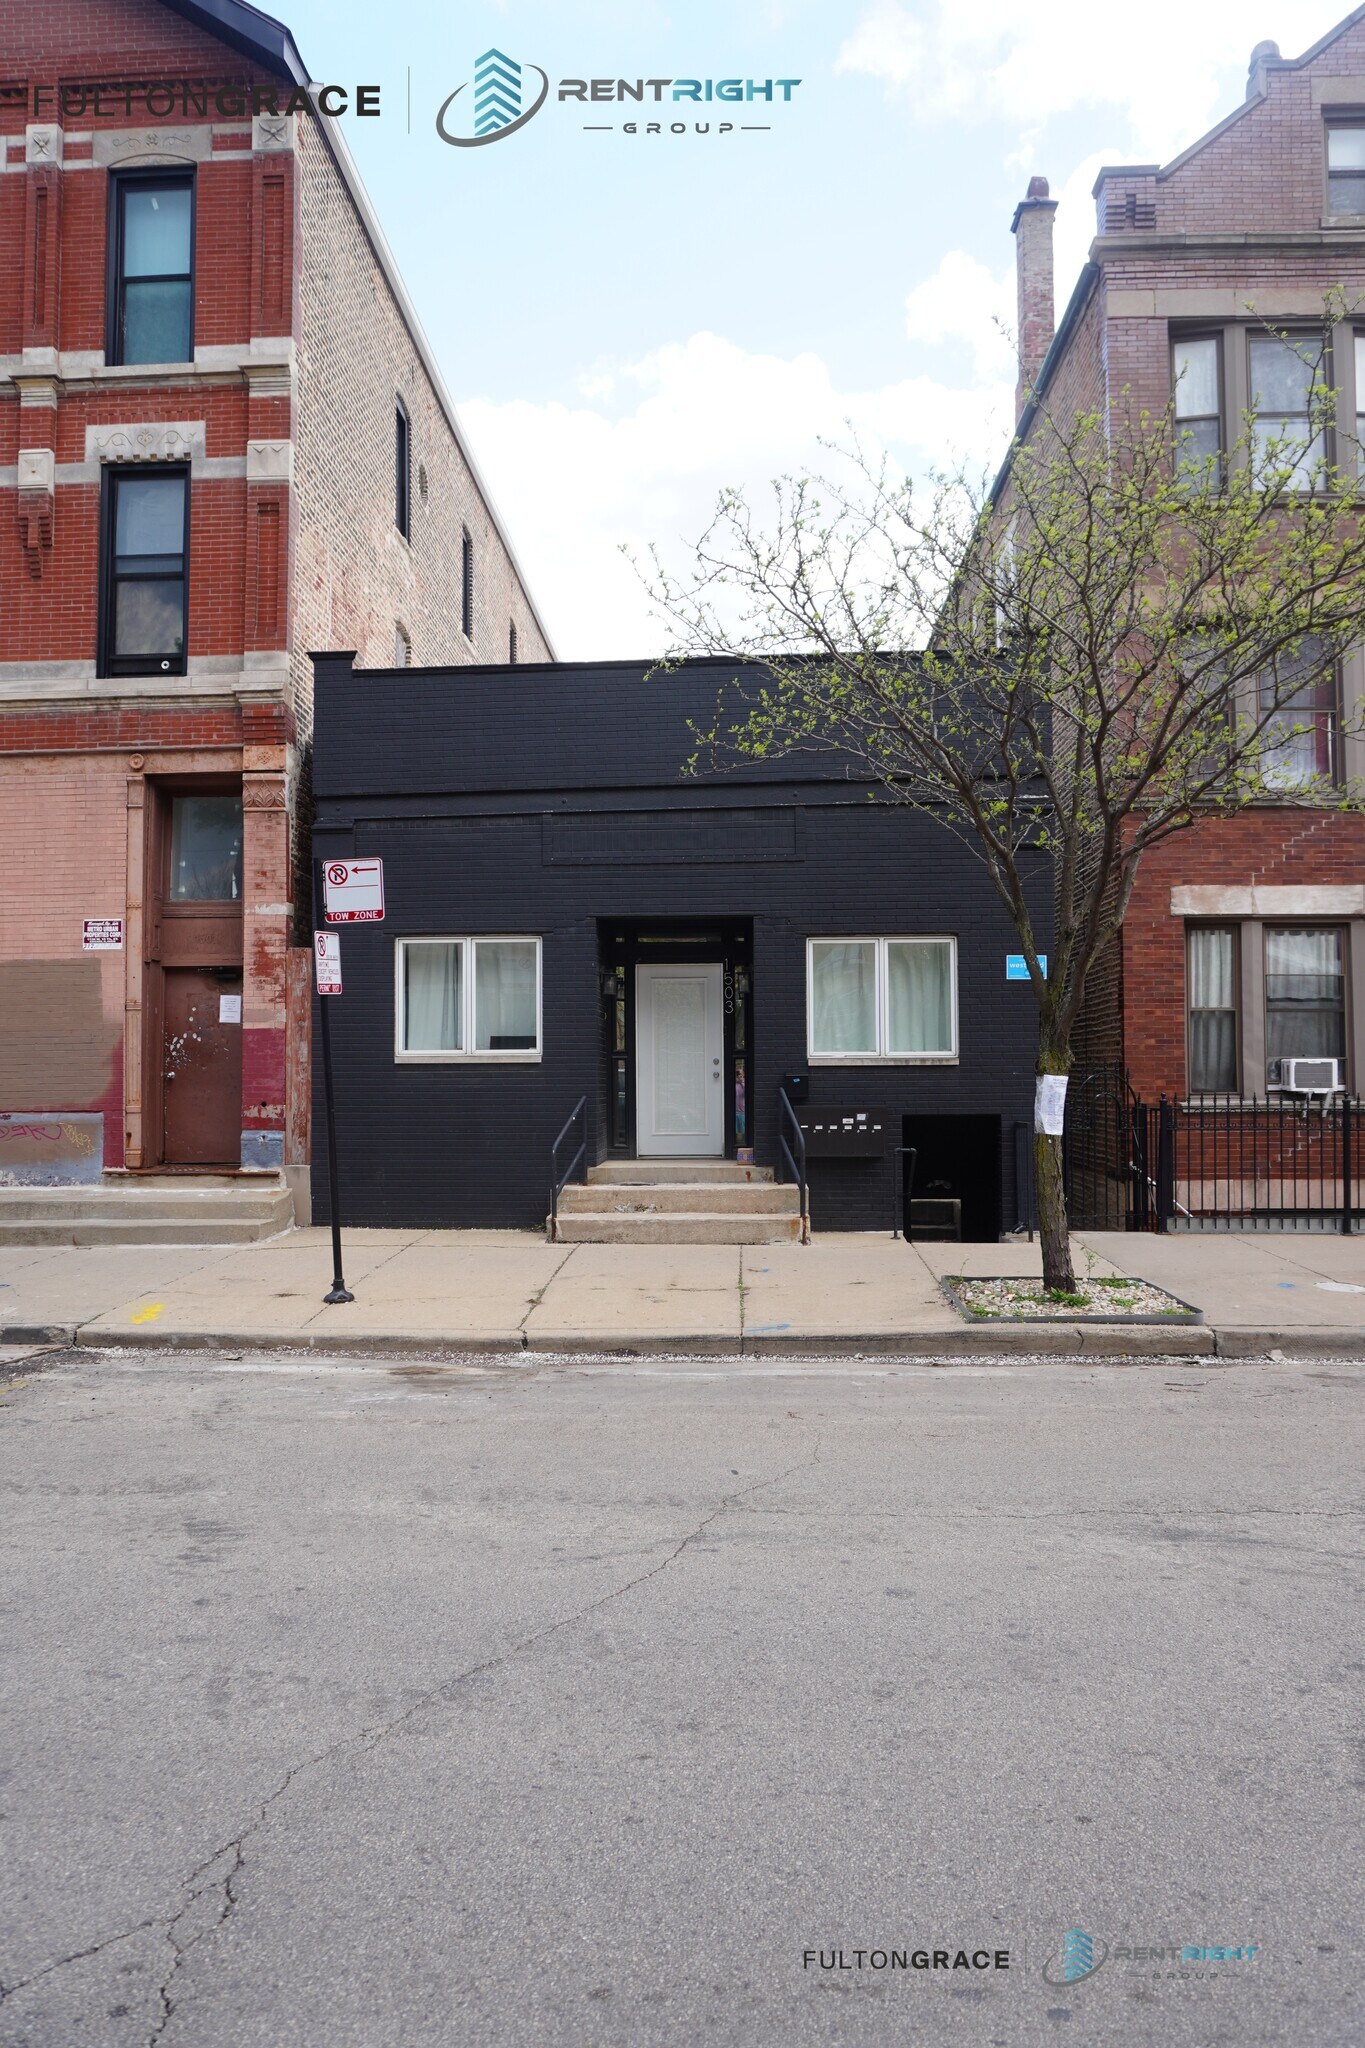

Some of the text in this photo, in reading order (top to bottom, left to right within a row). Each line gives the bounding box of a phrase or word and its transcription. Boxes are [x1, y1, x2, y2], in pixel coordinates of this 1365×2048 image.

[330, 910, 379, 920] TOW ZONE
[724, 958, 734, 1014] 1503
